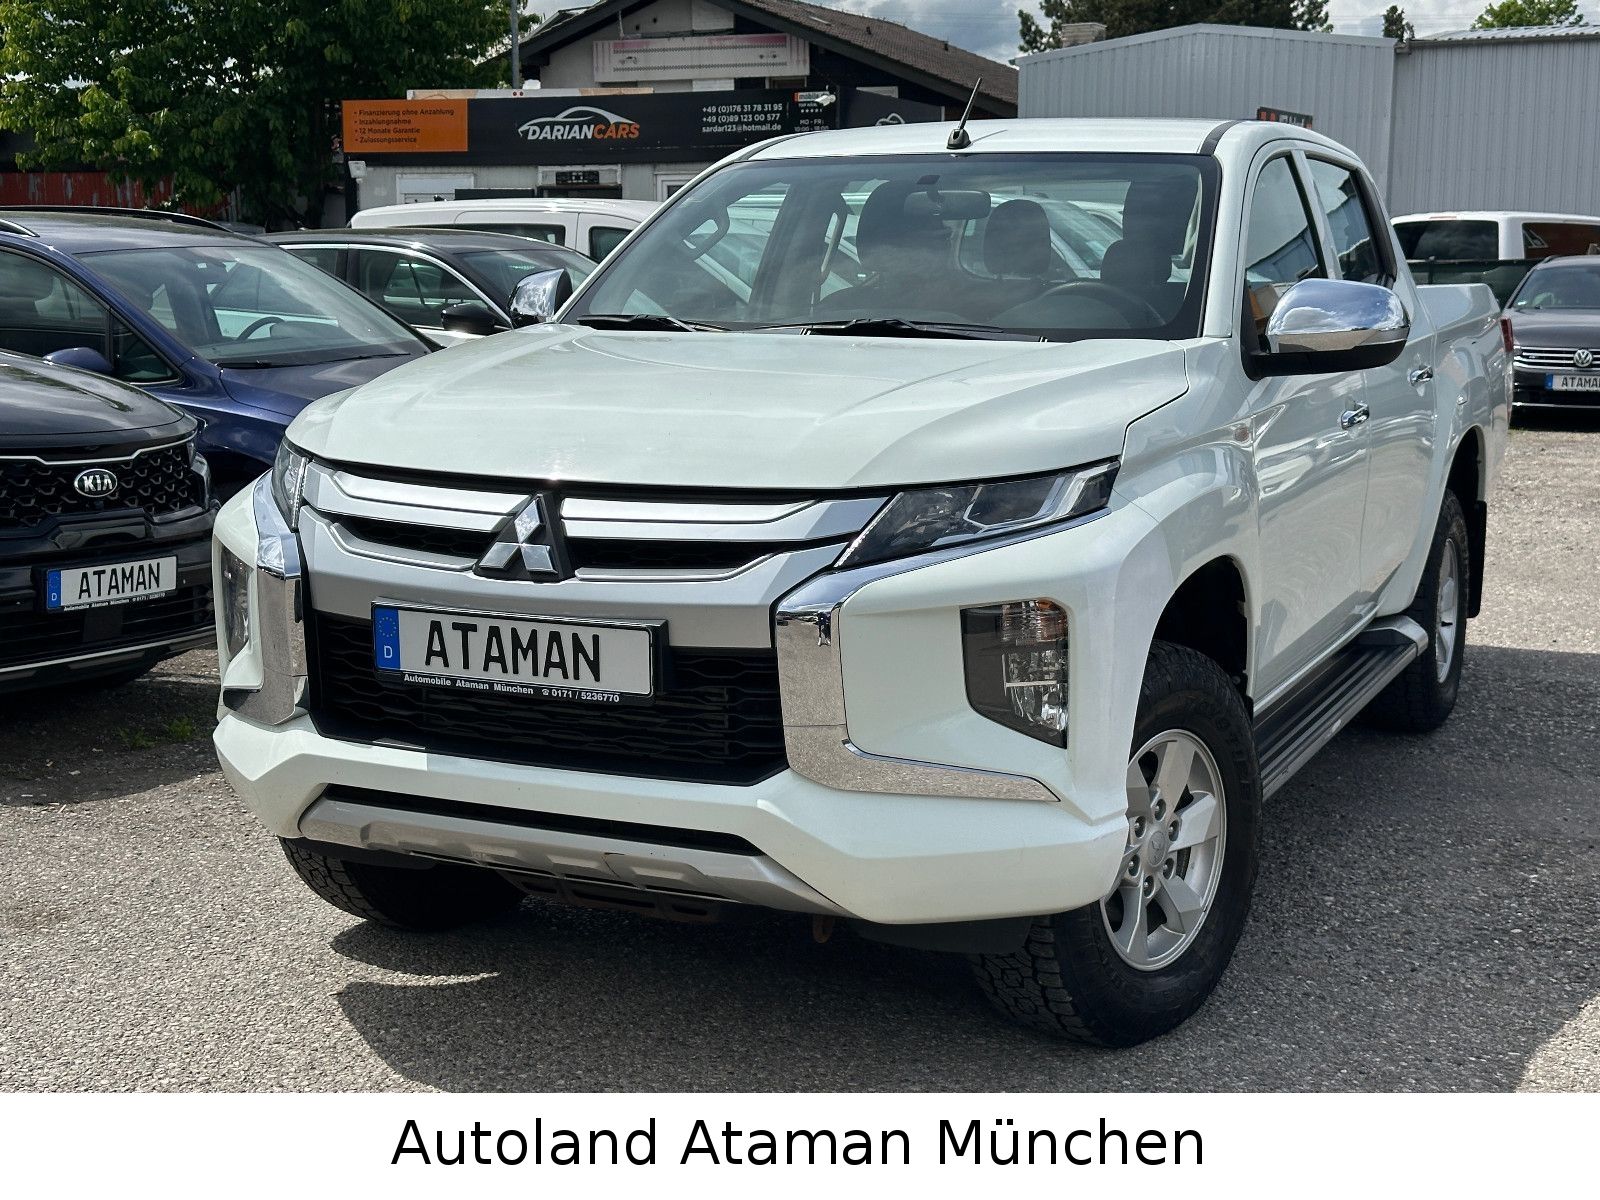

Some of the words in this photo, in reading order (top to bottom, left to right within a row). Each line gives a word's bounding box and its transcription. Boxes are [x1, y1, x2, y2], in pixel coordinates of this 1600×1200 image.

[359, 109, 400, 117] Finanzierung
[420, 108, 454, 116] Anzahlung
[702, 105, 716, 113] +49
[743, 104, 750, 112] 31
[773, 103, 782, 111] 95
[360, 118, 411, 126] Inzahlungnahme
[702, 114, 716, 122] +49
[718, 114, 738, 123] (0)89
[767, 113, 780, 121] 577
[527, 123, 640, 140] DARIANCARS
[82, 474, 113, 492] KIA
[78, 562, 160, 600] ATAMAN
[51, 592, 58, 602] D
[384, 645, 393, 659] D
[425, 620, 600, 682] ATAMAN
[404, 673, 451, 686] Automobile
[456, 679, 489, 690] Ataman
[493, 683, 534, 695] München
[551, 689, 574, 698] 0171
[581, 692, 620, 702] 5236770
